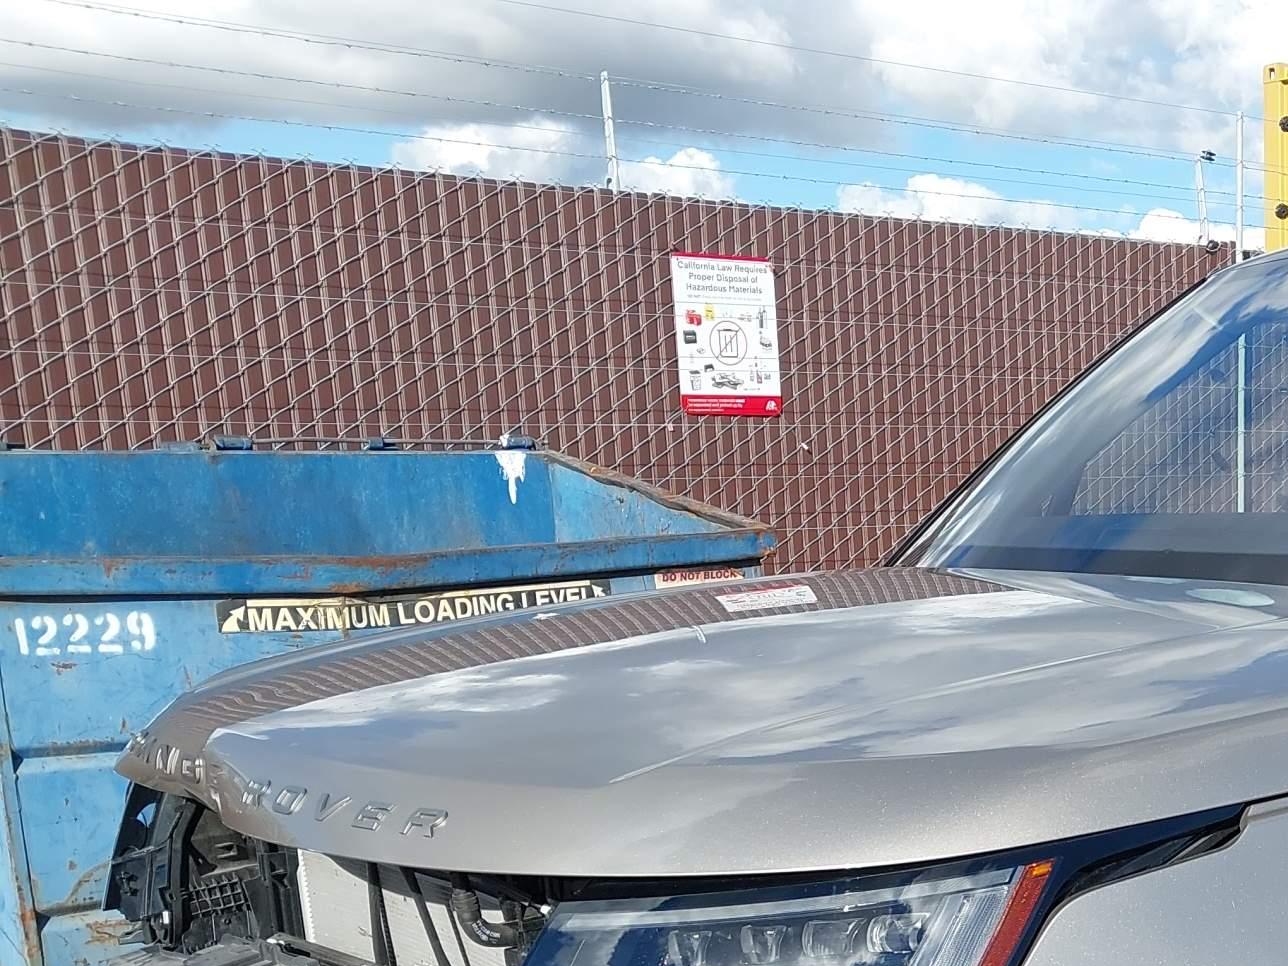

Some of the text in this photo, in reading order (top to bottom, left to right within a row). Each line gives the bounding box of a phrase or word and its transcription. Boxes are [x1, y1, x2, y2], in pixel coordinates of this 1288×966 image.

[677, 260, 768, 274] California Law Requires
[688, 271, 759, 284] Proper Disposal of
[686, 283, 763, 295] Hazardous Materials
[662, 573, 677, 582] DO
[680, 571, 700, 581] NOT
[247, 604, 391, 631] MAXIMUM
[396, 594, 515, 625] LOADING
[14, 611, 157, 657] 12229
[241, 780, 449, 839] ROVER
